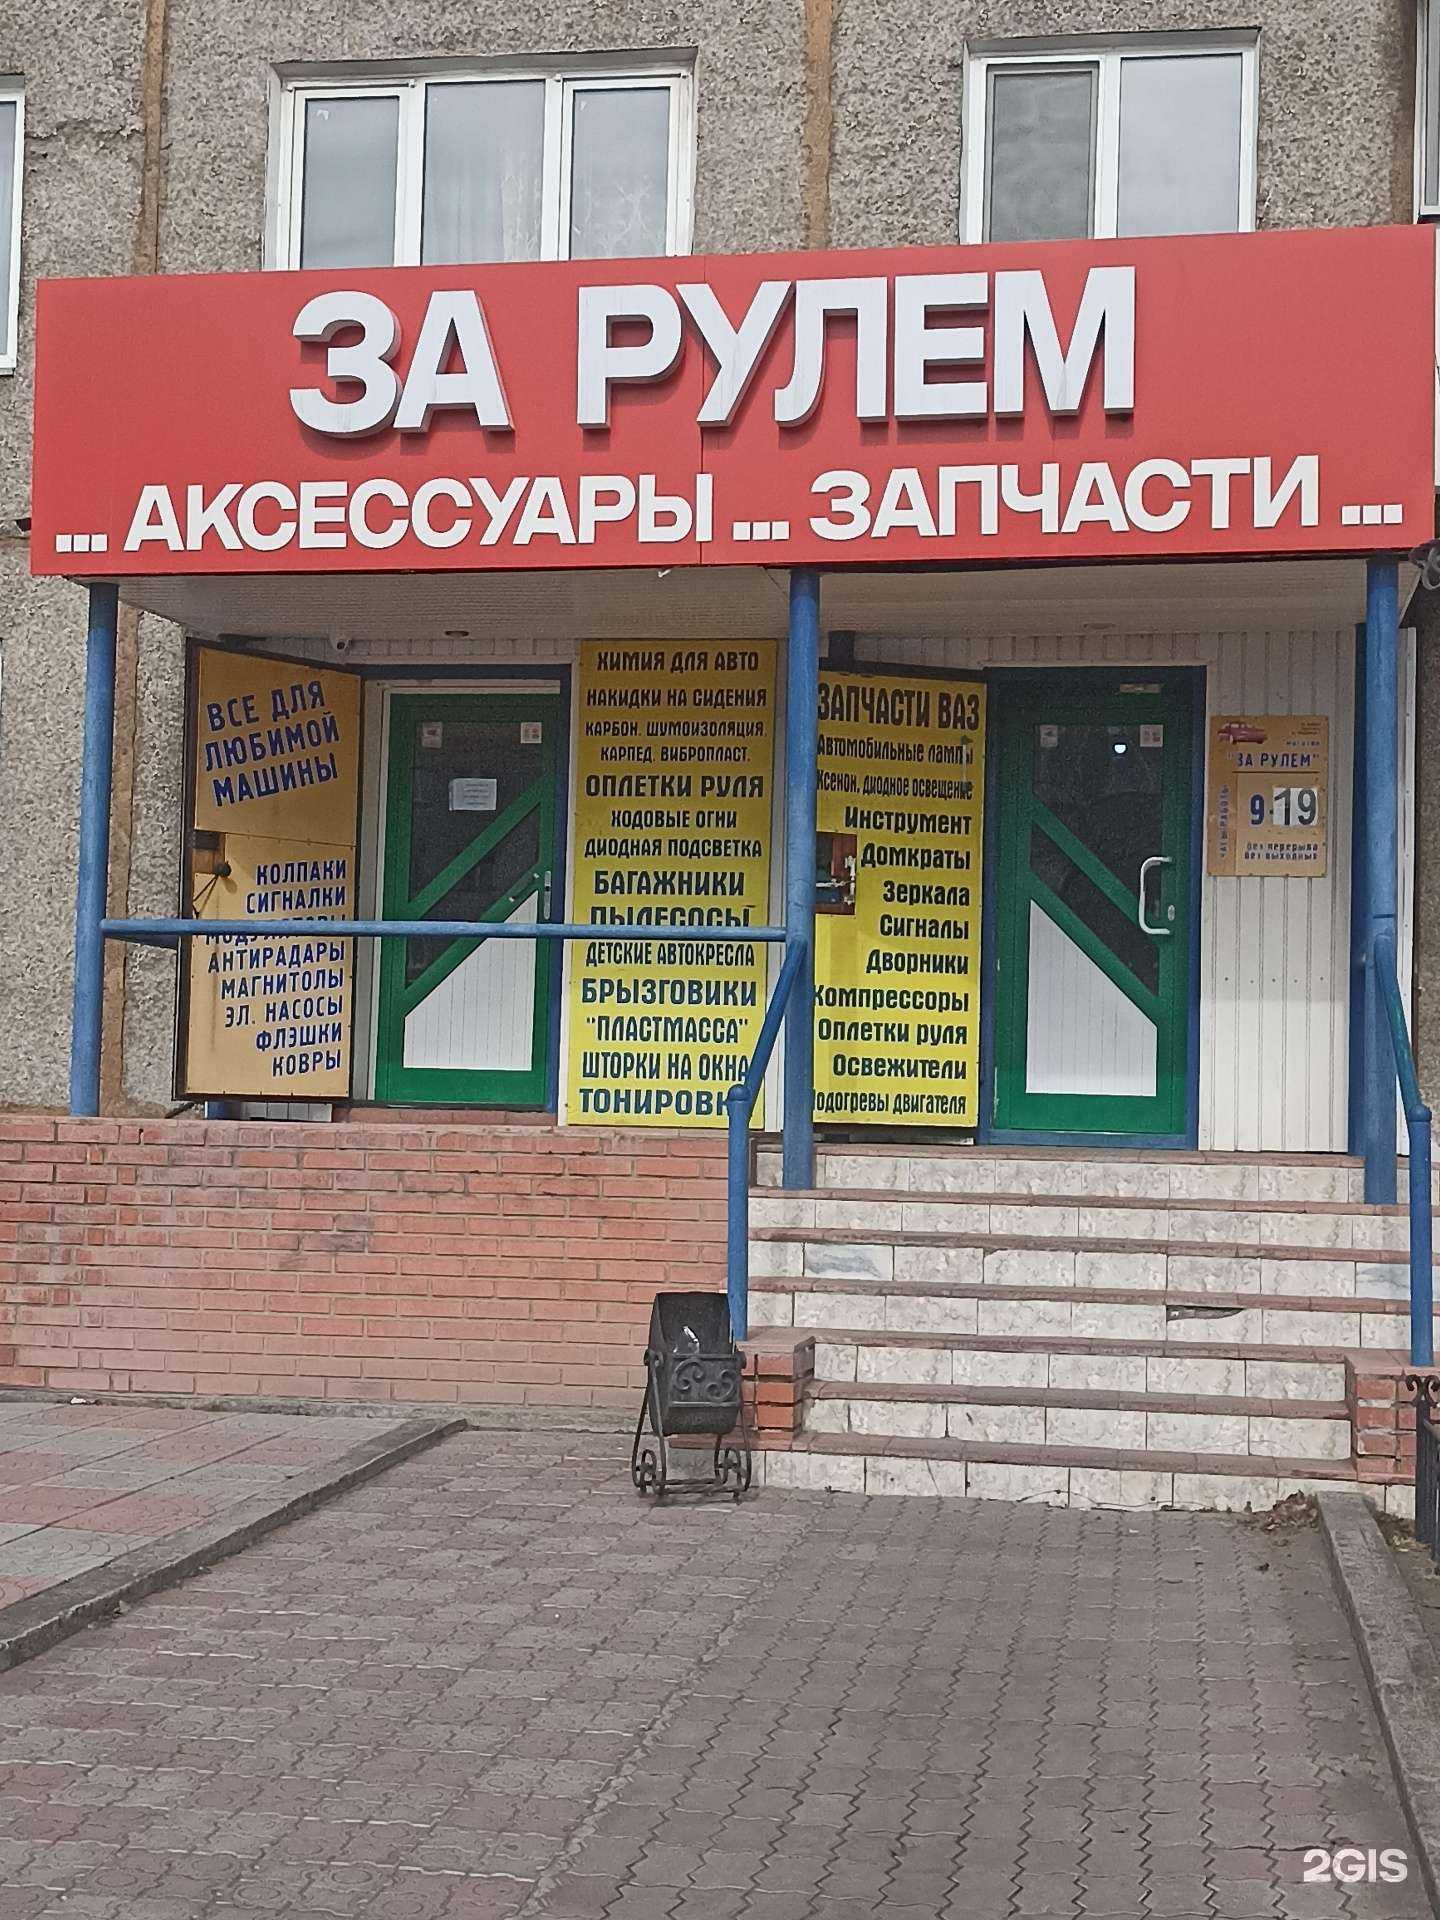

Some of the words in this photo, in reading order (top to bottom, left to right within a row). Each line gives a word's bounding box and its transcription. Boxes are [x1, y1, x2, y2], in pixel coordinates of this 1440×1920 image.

[290, 289, 515, 440] ЗА
[576, 265, 1136, 427] РУЛЕМ
[123, 473, 713, 552] АКСЕССУАРЫ
[809, 455, 1319, 541] ЗАПЧАСТИ
[597, 651, 665, 671] ХИМИЯ
[671, 651, 708, 674] ДЛЯ
[714, 651, 759, 671] АВТО
[206, 694, 260, 732] ВСЕ
[270, 680, 326, 723] ДЛЯ
[586, 688, 662, 708] НАКИДКИ
[666, 689, 687, 707] НА
[693, 689, 767, 709] СИДЕНИЯ
[818, 682, 930, 728] ЗАПЧАСТИ
[938, 692, 980, 731] ВАЗ
[205, 711, 340, 772] ЛЮБИМОЙ
[818, 734, 924, 763] Автомобильные
[212, 752, 338, 807] МАШИНЫ
[586, 775, 692, 797] ОПЛЕТКИ
[700, 775, 764, 798] РУЛЯ
[862, 775, 909, 797] диодное
[611, 810, 690, 829] ХОДОВЫЕ
[695, 810, 737, 828] ОГНИ
[845, 806, 972, 835] Инструмент
[584, 838, 662, 858] ДИОДНАЯ
[667, 839, 762, 858] ПОДСВЕТКА
[861, 843, 970, 869] Домкраты
[256, 860, 346, 886] КОЛПАКИ
[594, 870, 745, 896] БАГАЖНИКИ
[246, 886, 346, 914] СИГНАЛКИ
[883, 880, 970, 906] Зеркала
[880, 914, 968, 940] Сигналы
[207, 941, 345, 974] АНТИРАДАРЫ
[586, 942, 652, 967] ДЕТСКИЕ
[657, 943, 755, 967] АВТОКРЕСЛА
[866, 949, 968, 974] Дворники
[221, 968, 344, 1000] МАГНИТОЛЫ
[581, 978, 757, 1006] БРЫЗГОВИКИ
[815, 984, 968, 1012] Компрессоры
[225, 1004, 256, 1028] ЭЛ.
[265, 995, 343, 1023] НАСОСЫ
[255, 1022, 342, 1052] ФЛЭШКИ
[586, 1016, 748, 1043] "ПЛАСТМАССА"
[818, 1018, 909, 1042] Оплетки
[917, 1023, 967, 1046] руля
[272, 1049, 341, 1077] КОВРЫ
[582, 1052, 661, 1080] ШТОРКИ
[667, 1054, 692, 1080] НА
[699, 1053, 749, 1082] ОКНА
[833, 1054, 967, 1079] Освежители
[579, 1089, 729, 1116] ТОНИРОВК
[813, 1089, 889, 1113] одогревы
[893, 1093, 966, 1115] двигателя
